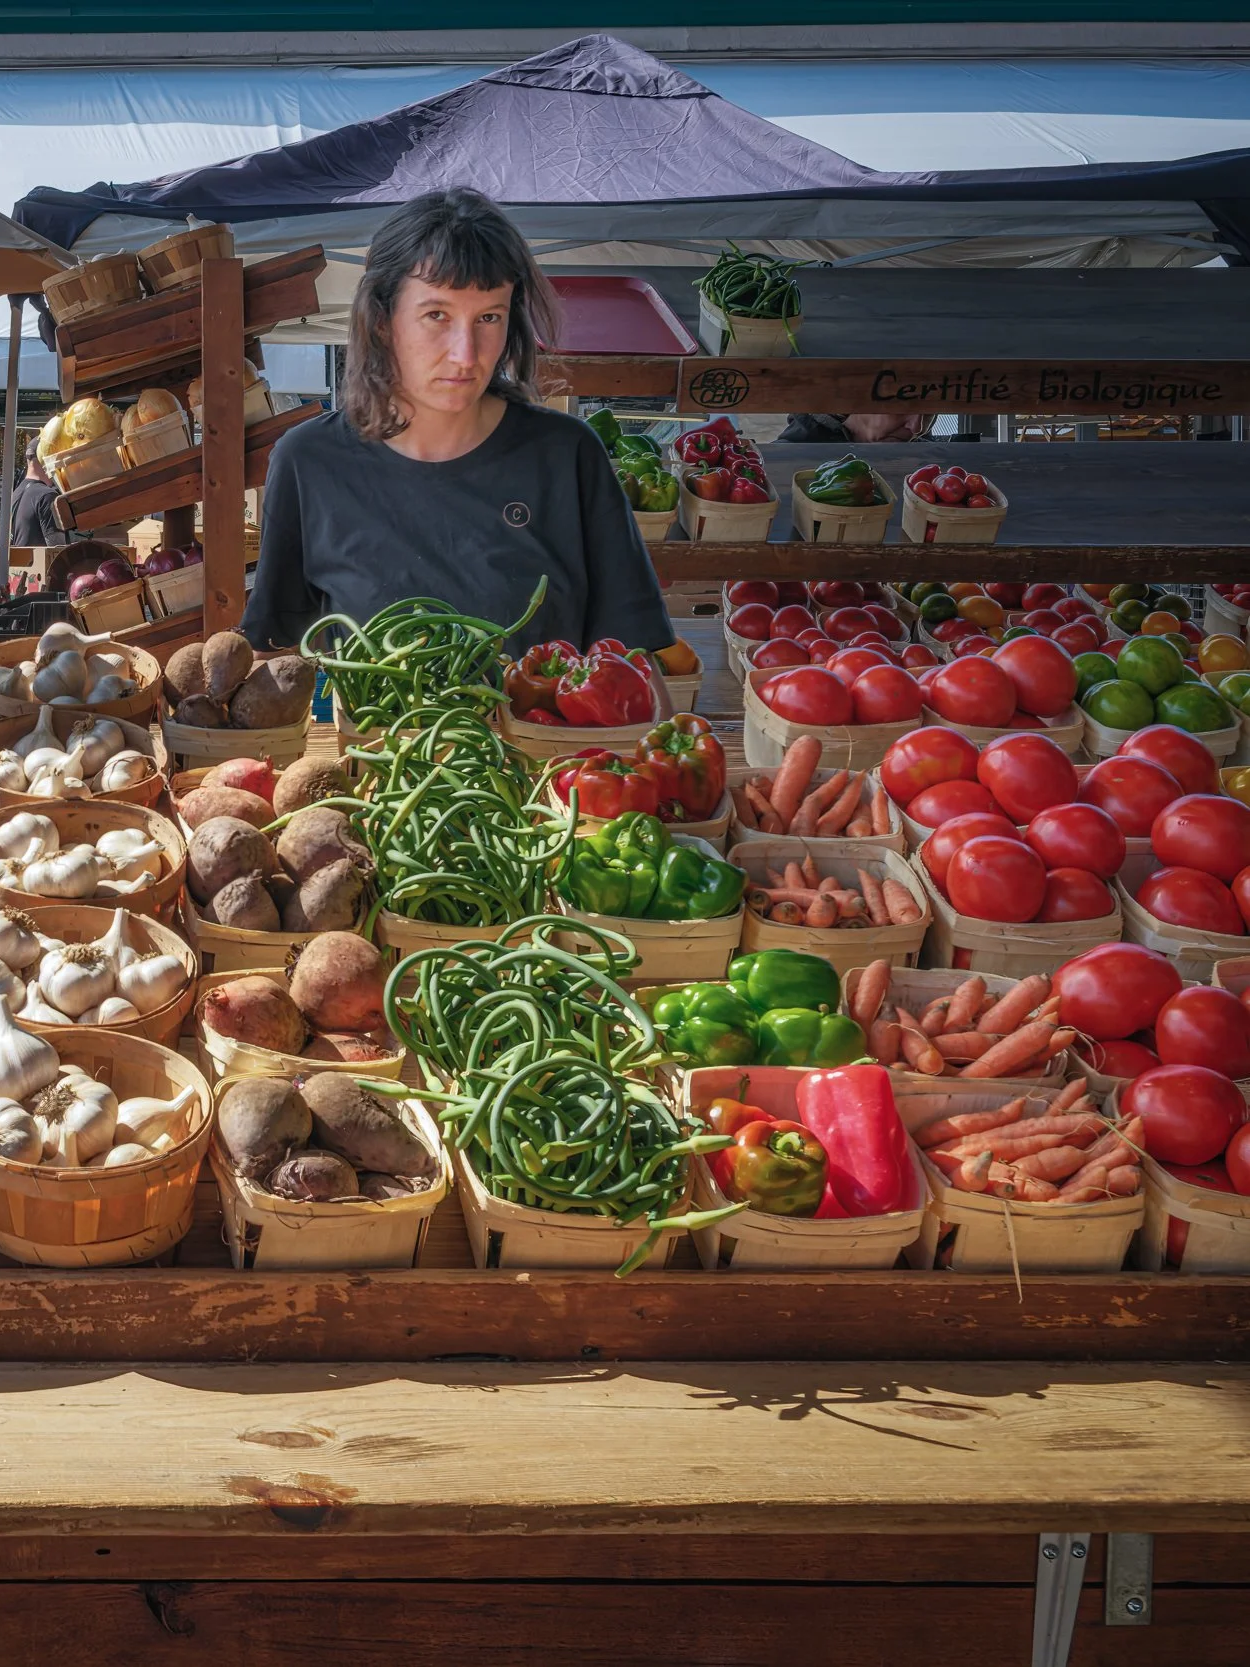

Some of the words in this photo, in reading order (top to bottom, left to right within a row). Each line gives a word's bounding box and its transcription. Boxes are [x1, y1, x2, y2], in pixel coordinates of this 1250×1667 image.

[701, 371, 737, 388] ECO
[700, 386, 741, 404] CERT
[870, 368, 1010, 403] Certifié
[1038, 368, 1224, 410] biologique
